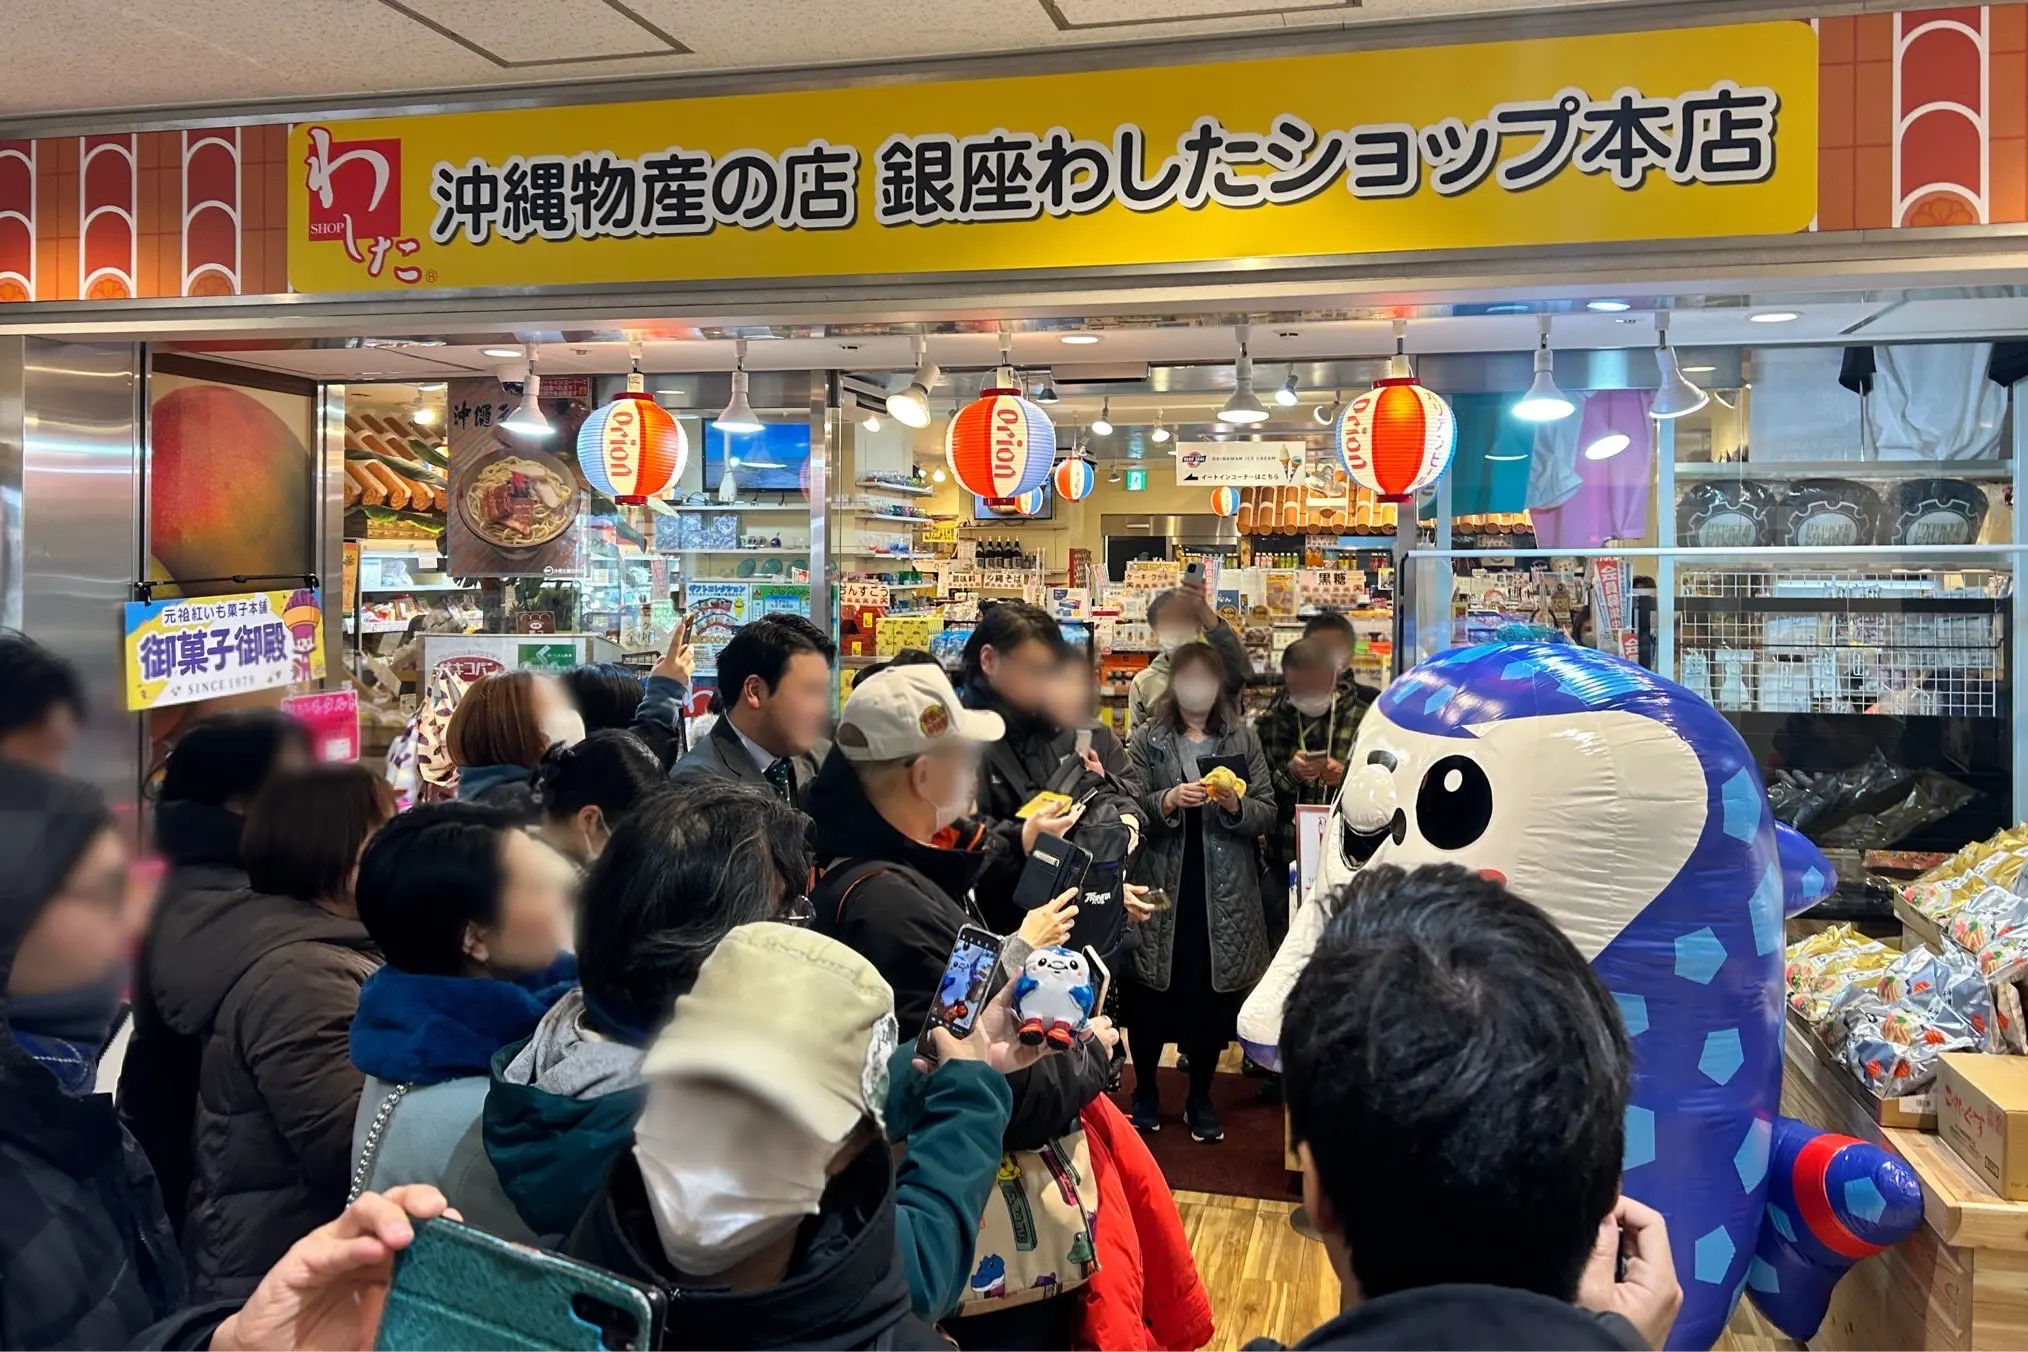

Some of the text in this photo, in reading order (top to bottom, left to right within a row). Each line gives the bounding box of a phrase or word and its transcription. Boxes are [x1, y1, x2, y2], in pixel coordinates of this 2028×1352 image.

[431, 83, 1779, 243] 沖縄物産の店 銀座わしたショップ本店
[304, 126, 422, 284] わした
[310, 223, 345, 235] SHOP
[610, 411, 637, 478] Orion
[994, 409, 1023, 479] Orion
[1346, 398, 1371, 470] Orion
[953, 574, 975, 583] 調味料
[1318, 572, 1346, 585] 黒糖
[164, 599, 268, 624] 元祖紅いも菓子本舗
[140, 621, 288, 681] 御菓子御殿
[188, 680, 225, 695] SINCE
